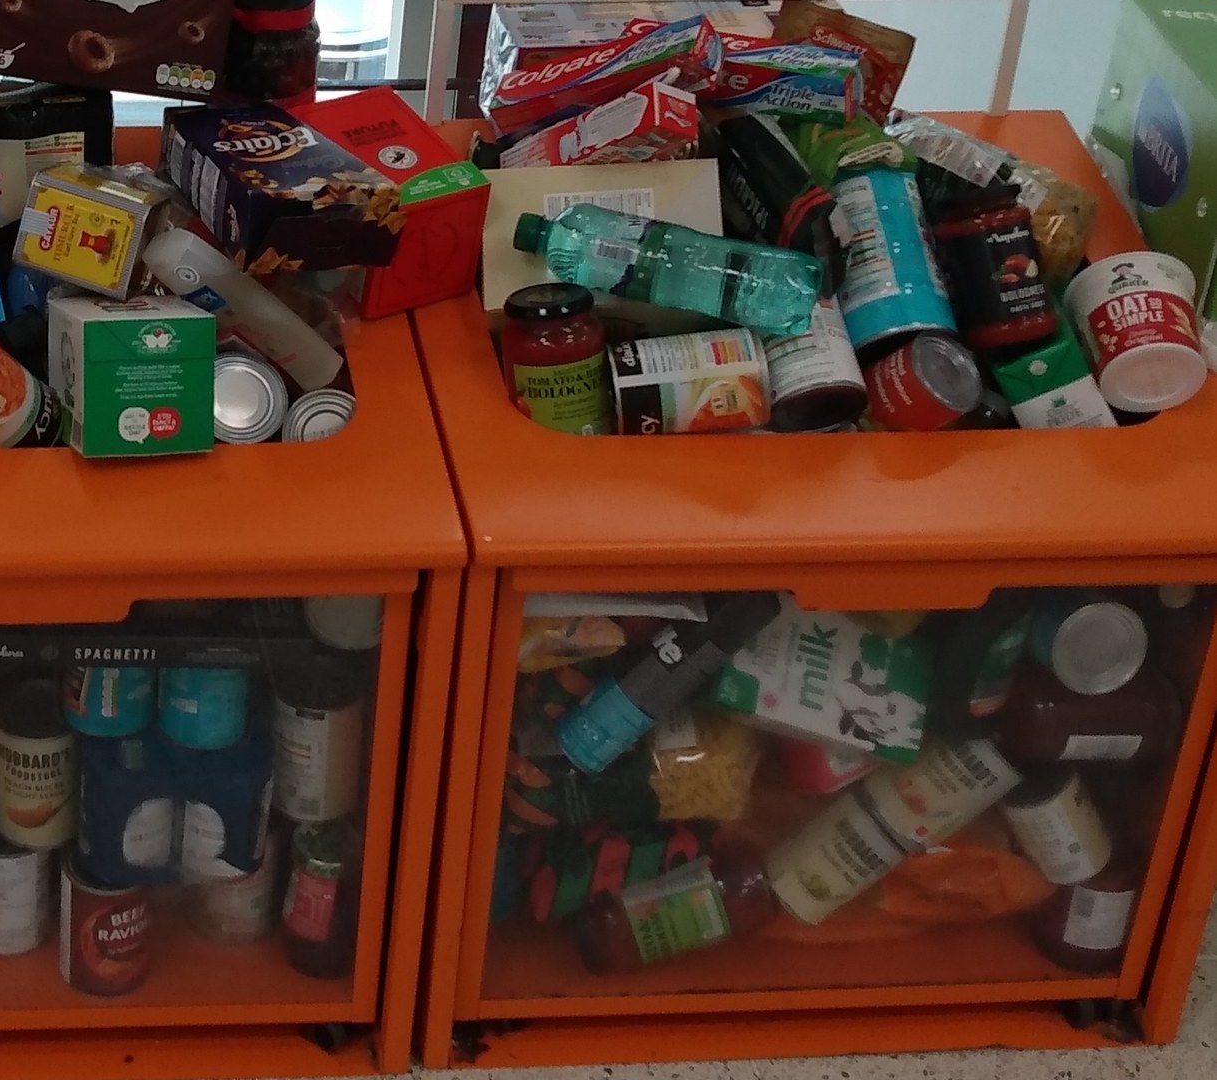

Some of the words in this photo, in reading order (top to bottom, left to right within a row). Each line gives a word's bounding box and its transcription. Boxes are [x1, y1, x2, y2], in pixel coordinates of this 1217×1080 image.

[766, 52, 815, 69] Action
[777, 46, 824, 64] Triple
[502, 46, 615, 91] Colgate
[760, 92, 813, 112] Action
[770, 82, 816, 102] Triple
[213, 126, 320, 153] Eclairs
[1107, 279, 1149, 295] QUAKER
[1105, 293, 1150, 318] OAT
[1112, 310, 1165, 332] SIMPLE
[74, 647, 157, 660] SPAGHETTI
[798, 621, 839, 711] milk
